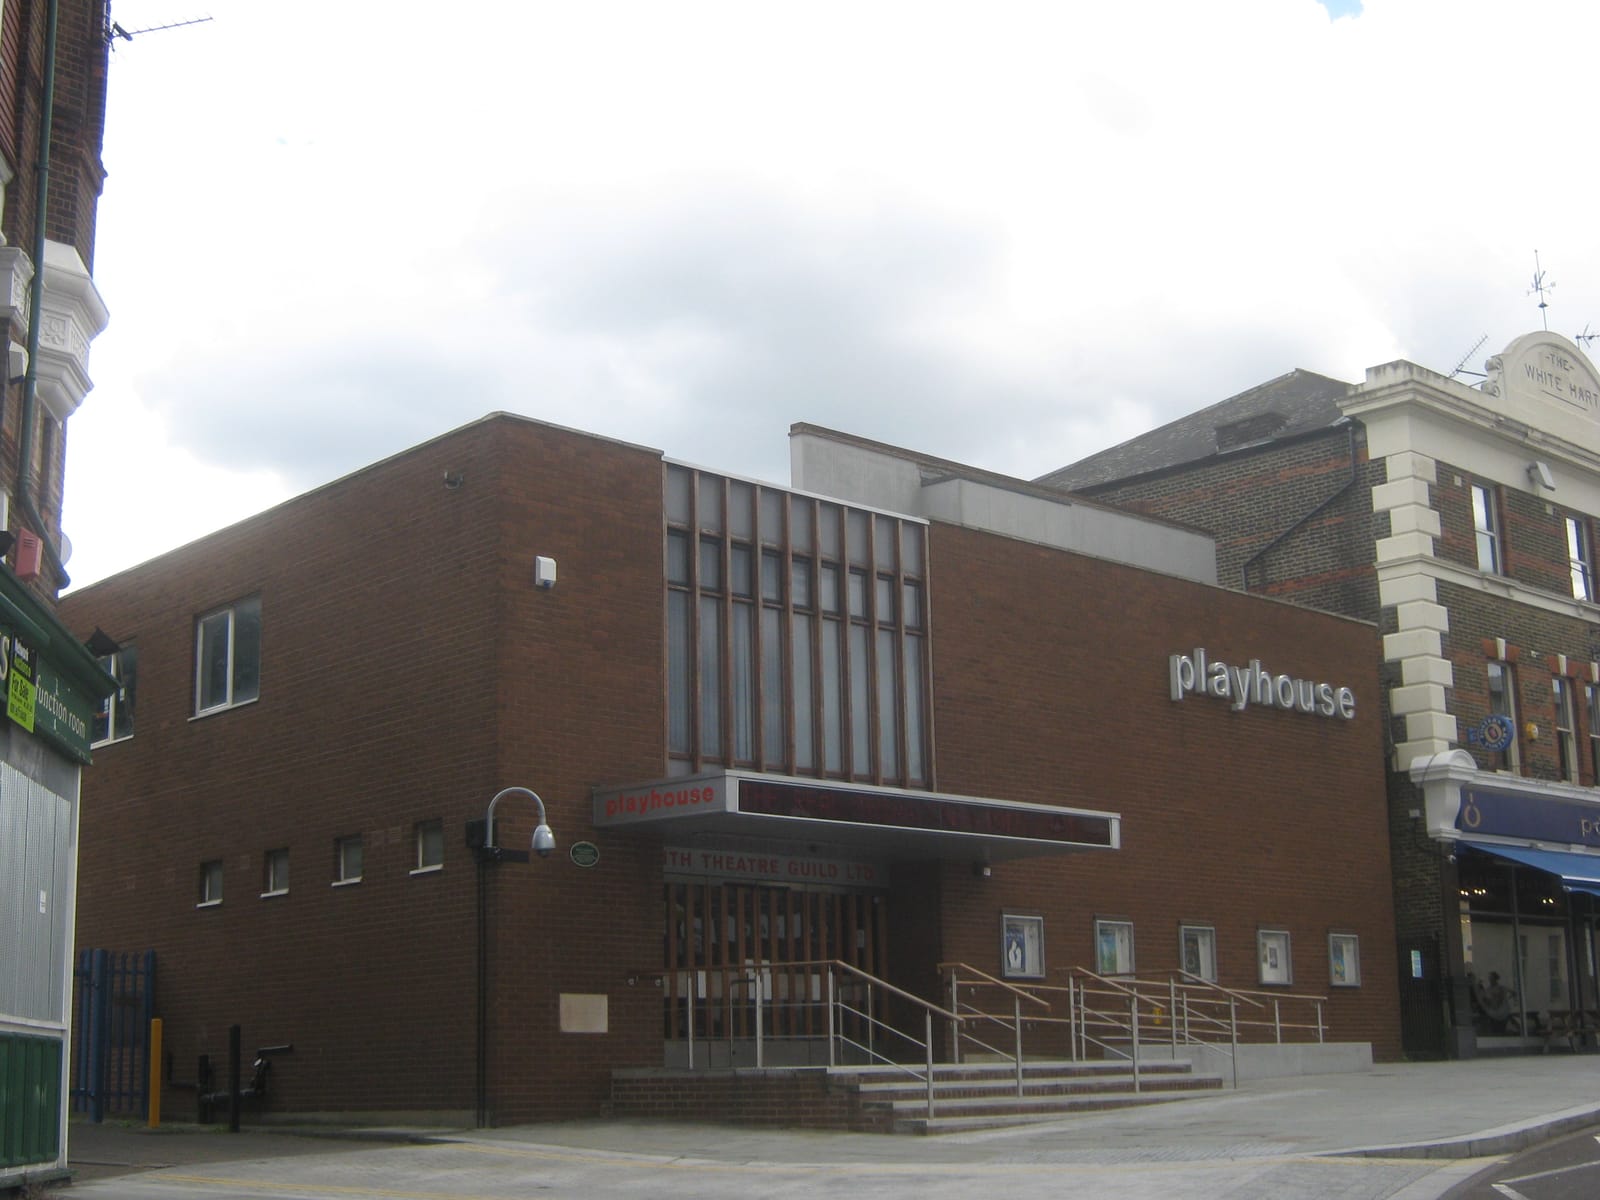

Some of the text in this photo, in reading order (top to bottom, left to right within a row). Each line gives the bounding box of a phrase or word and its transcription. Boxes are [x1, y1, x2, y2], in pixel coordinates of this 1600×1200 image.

[1524, 363, 1600, 408] WHITE HART
[1169, 647, 1355, 720] playhouse
[68, 712, 86, 739] room
[605, 786, 715, 816] playhouse
[701, 852, 780, 875] THEATRE
[787, 860, 838, 880] GUILD
[846, 863, 876, 882] LTD
